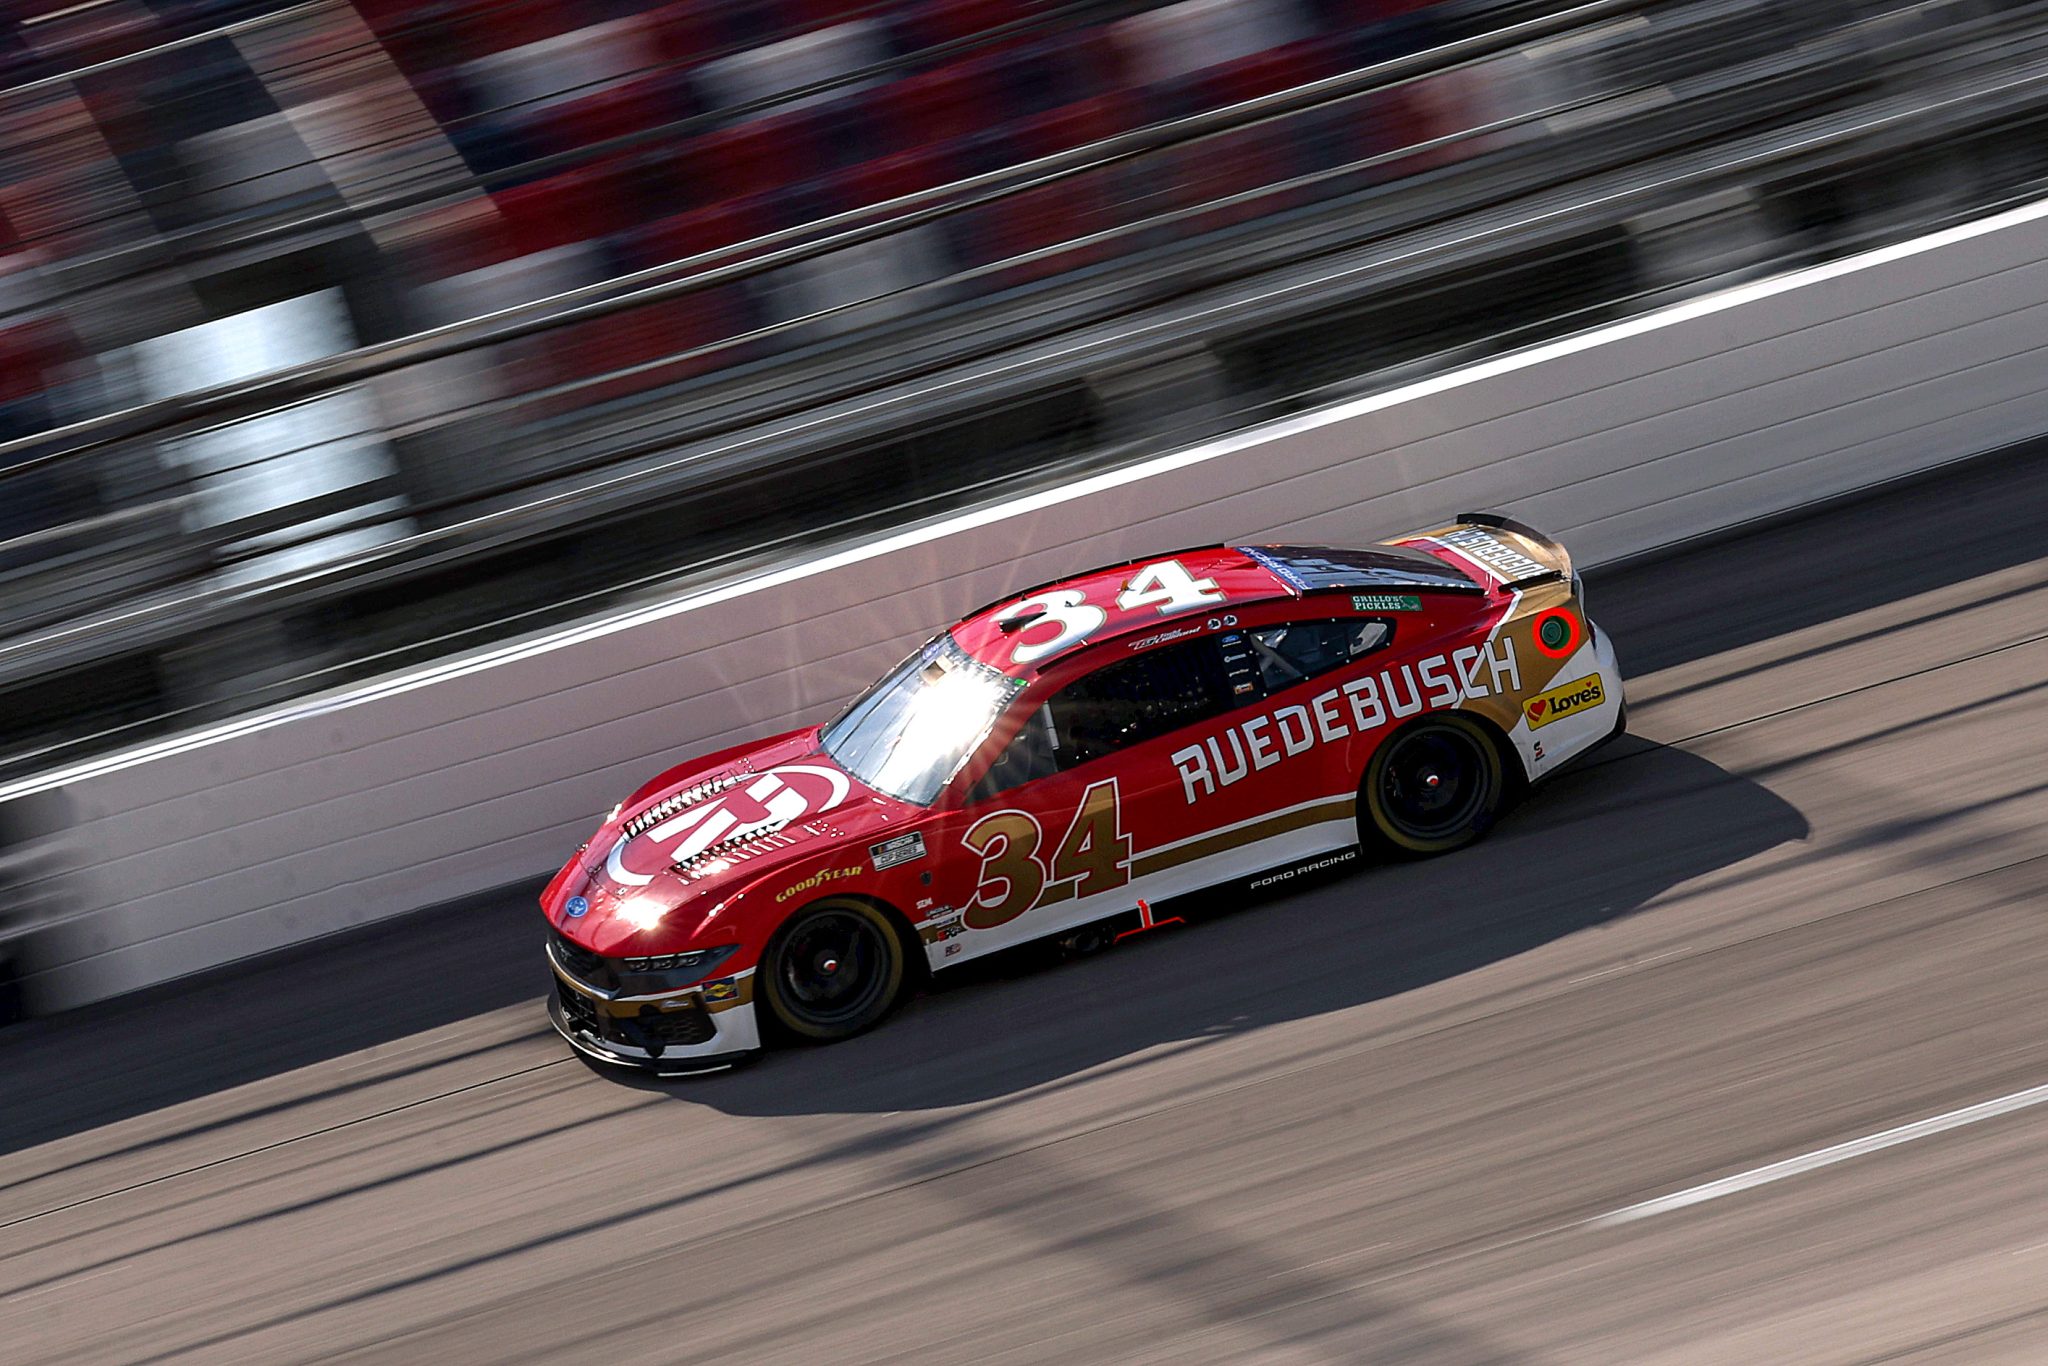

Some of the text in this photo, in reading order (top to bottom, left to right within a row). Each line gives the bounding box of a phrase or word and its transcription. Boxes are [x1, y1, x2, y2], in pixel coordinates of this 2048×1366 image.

[990, 559, 1226, 664] 34
[1352, 595, 1400, 603] GRILLO'S
[1354, 602, 1401, 610] PICKLES
[1170, 636, 1522, 805] RUEDEBUSCH
[961, 776, 1133, 930] 34
[1250, 851, 1357, 890] FORD RACING
[775, 866, 863, 903] GOODYEAR
